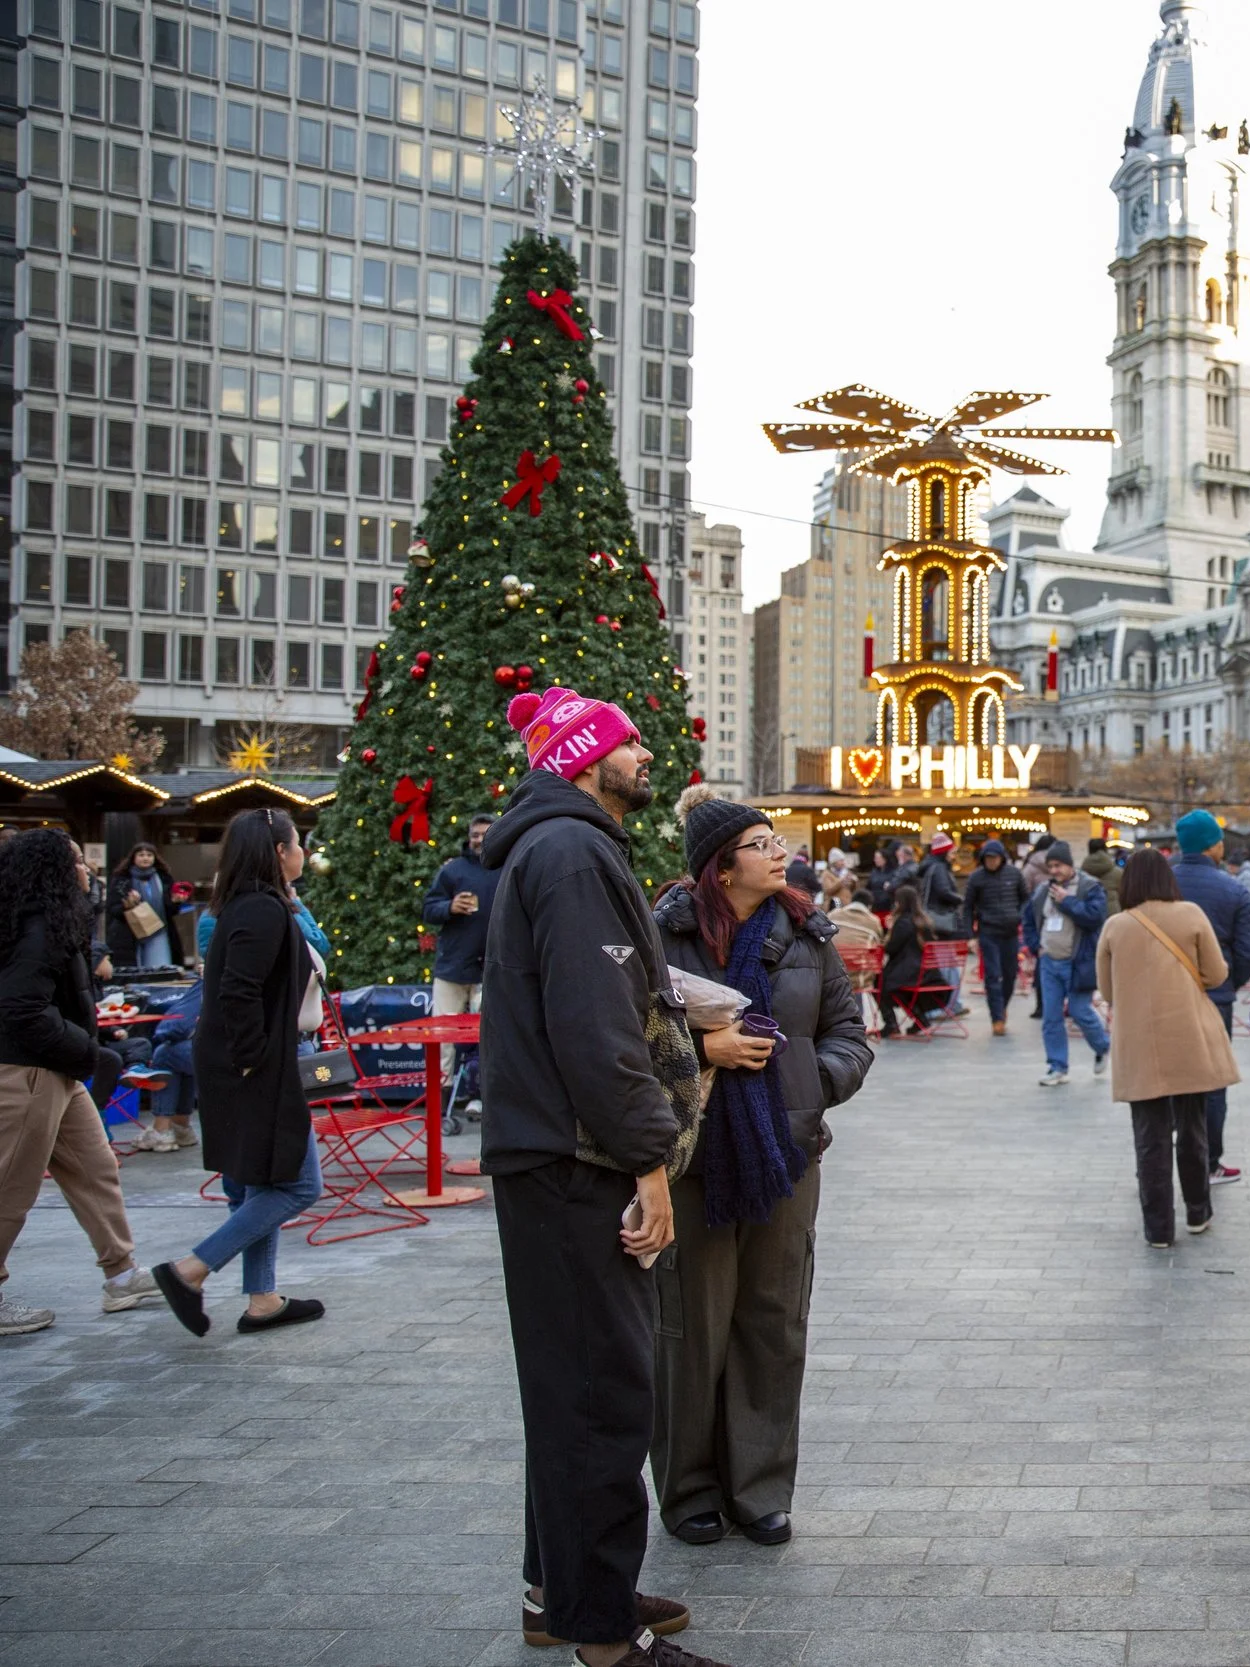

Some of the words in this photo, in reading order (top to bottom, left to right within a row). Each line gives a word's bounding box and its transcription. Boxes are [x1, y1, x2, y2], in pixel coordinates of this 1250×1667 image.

[831, 746, 842, 790] I
[890, 744, 1041, 790] PHILLY
[378, 1058, 426, 1069] Presented
